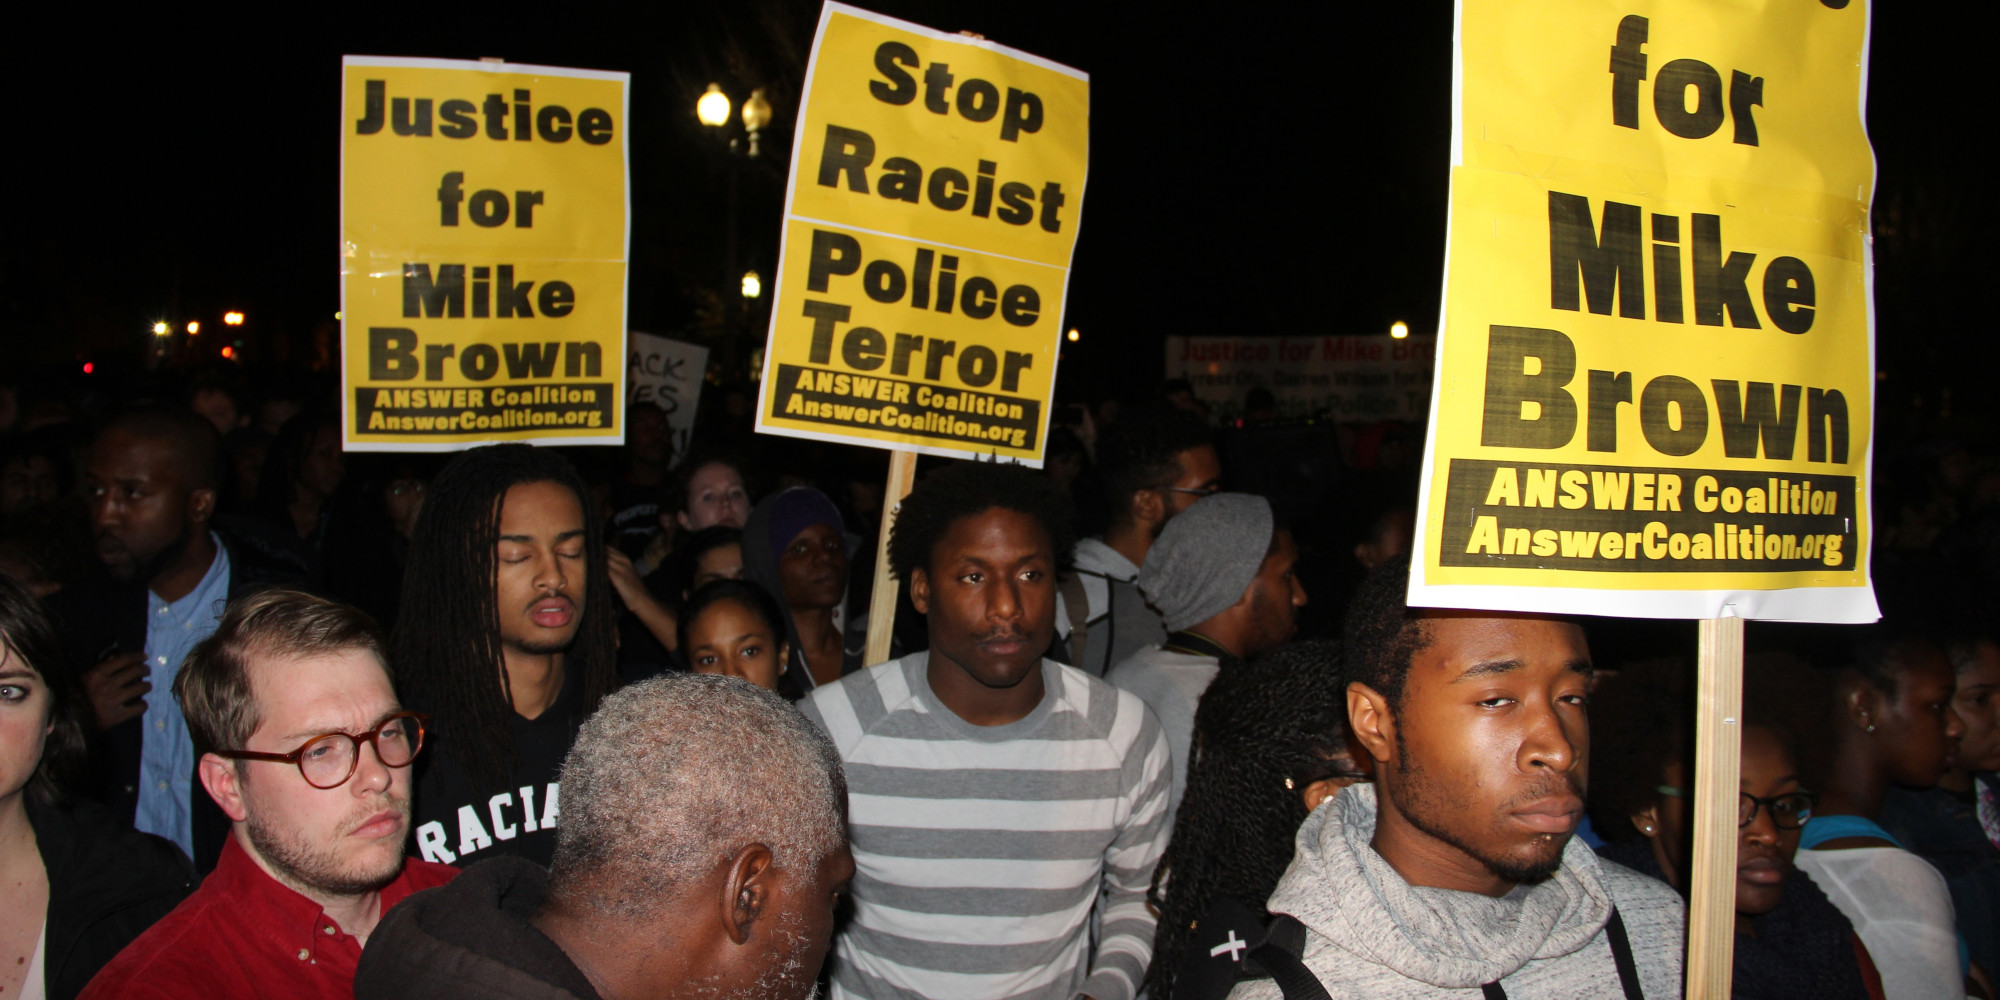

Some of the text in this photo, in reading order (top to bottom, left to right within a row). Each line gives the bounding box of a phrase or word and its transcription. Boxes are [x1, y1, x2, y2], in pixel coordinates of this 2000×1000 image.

[869, 41, 1044, 142] Stop
[1609, 14, 1764, 148] for
[356, 80, 614, 145] Justice
[437, 171, 544, 228] for
[817, 124, 1065, 234] Racist
[807, 229, 1041, 327] Police
[1548, 190, 1816, 335] Mike
[402, 263, 575, 319] Mike
[368, 327, 602, 382] Brown
[802, 299, 1033, 393] Terror
[1180, 336, 1270, 362] Justice
[1278, 336, 1314, 362] for
[1321, 336, 1384, 362] Mike
[368, 409, 602, 431] AnswerCoalition.org
[375, 386, 596, 409] ANSWER Coalition
[785, 392, 1027, 446] AnswerCoalition.org
[796, 369, 1023, 420] ANSWER Coalition
[1481, 324, 1850, 465] Brown
[1485, 468, 1838, 516] ANSWER Coalition
[1467, 516, 1844, 566] AnswerCoalition.org
